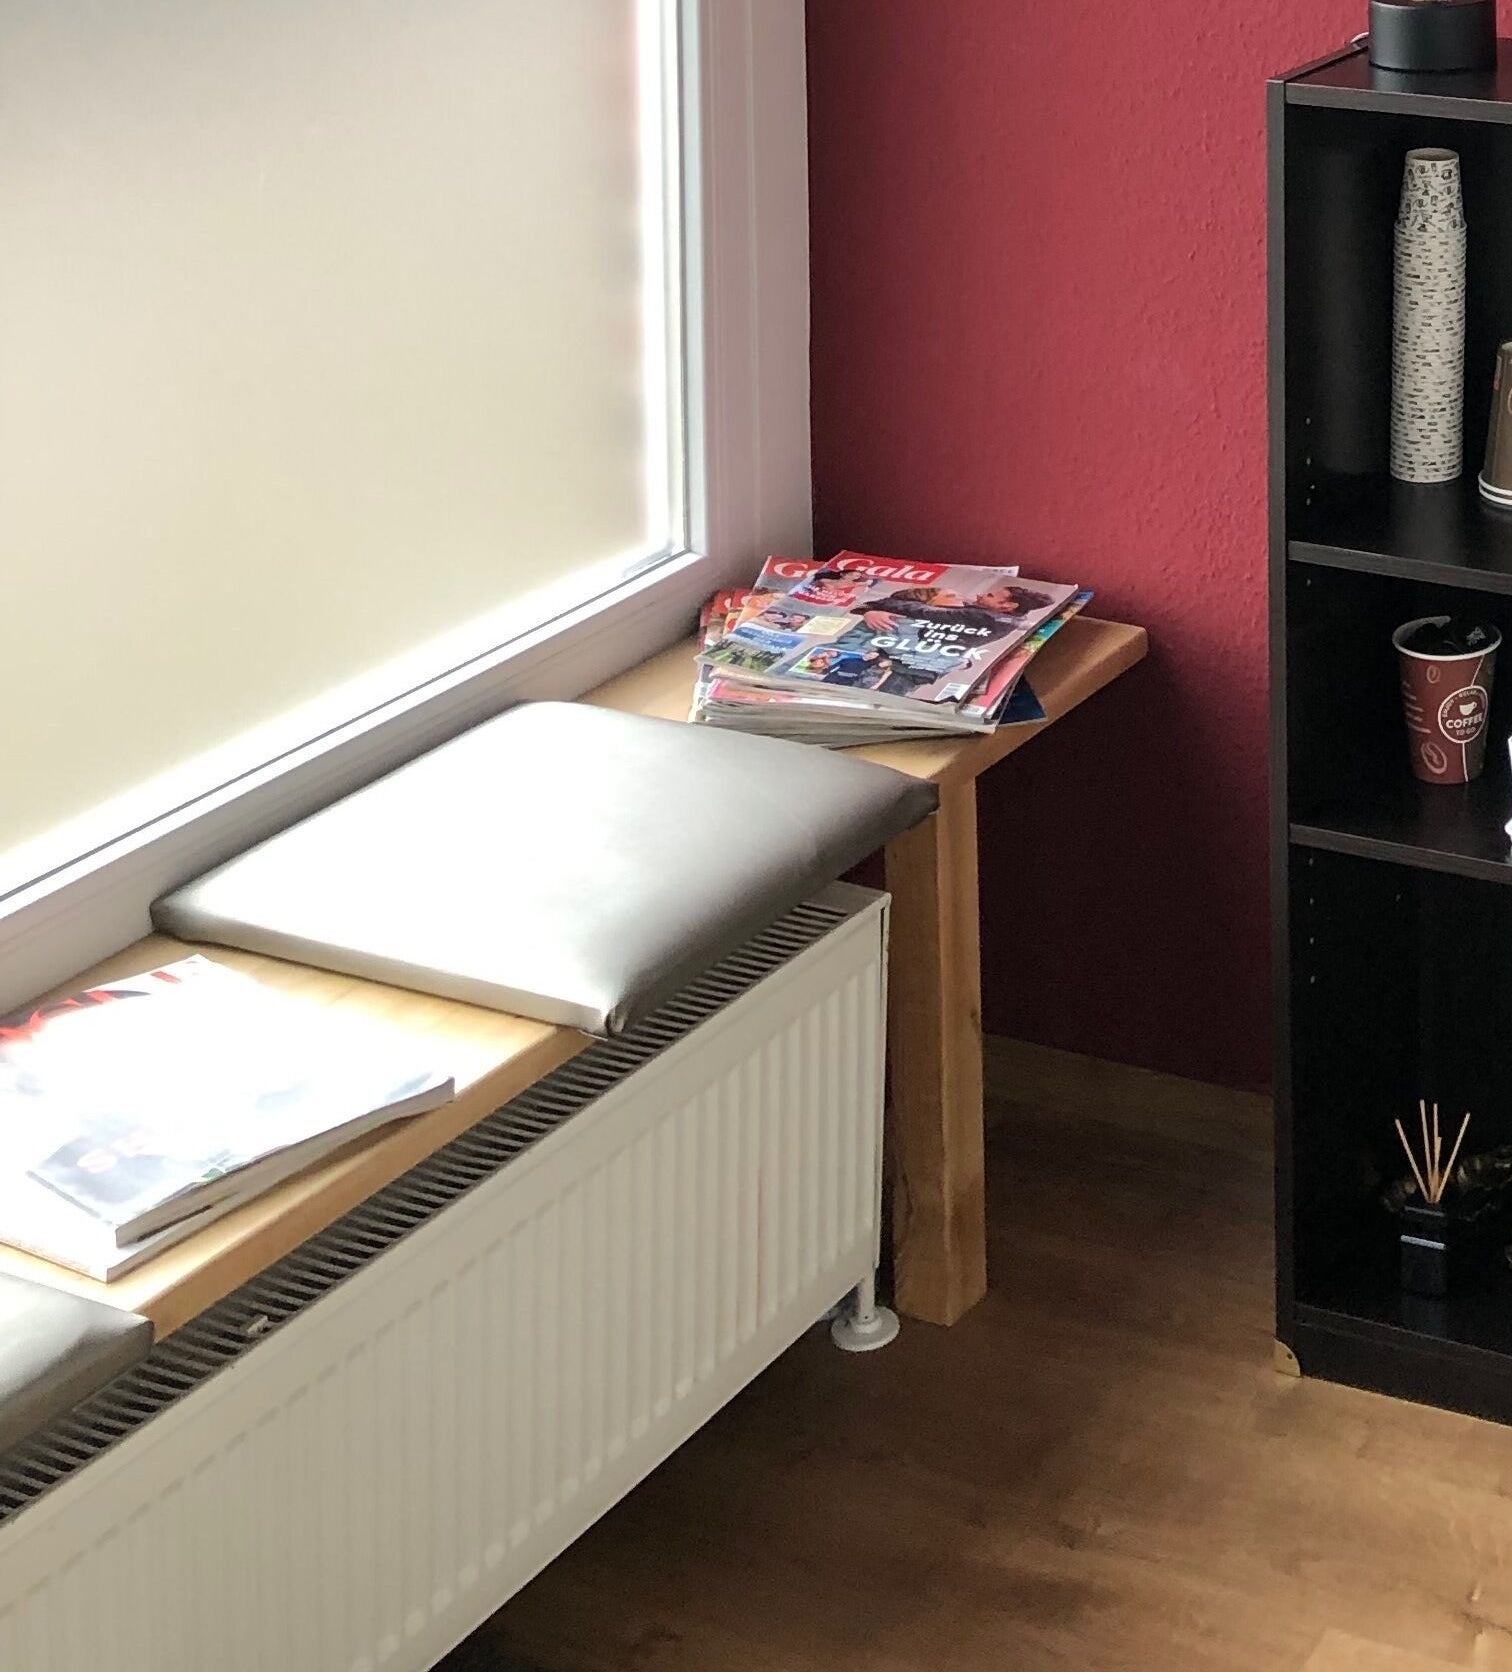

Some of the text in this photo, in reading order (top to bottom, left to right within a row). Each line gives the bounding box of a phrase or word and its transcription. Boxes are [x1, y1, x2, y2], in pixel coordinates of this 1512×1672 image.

[837, 558, 936, 581] Gala
[911, 619, 992, 637] Zurück
[923, 629, 959, 641] ins
[870, 636, 990, 661] GLÜCK
[1446, 713, 1482, 729] COFFEE
